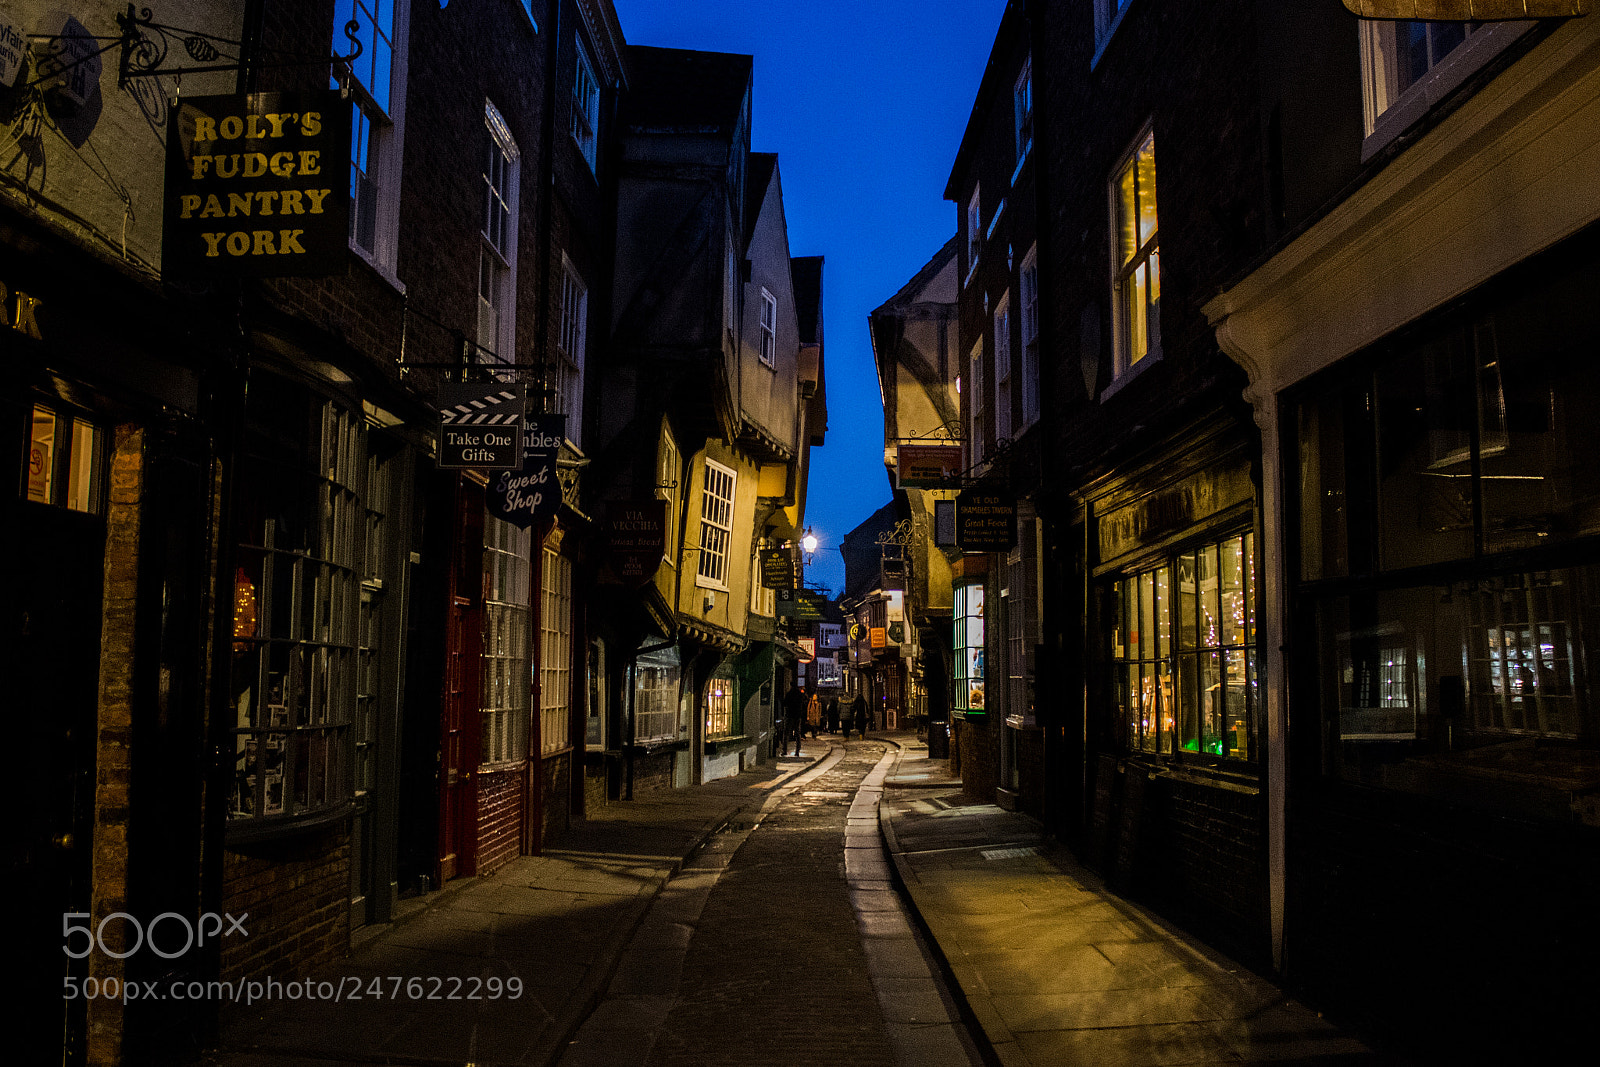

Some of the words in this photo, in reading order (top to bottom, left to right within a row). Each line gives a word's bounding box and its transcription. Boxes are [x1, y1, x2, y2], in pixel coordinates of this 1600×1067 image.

[0, 24, 24, 51] yfair
[0, 45, 18, 68] urity
[194, 112, 322, 141] ROLY'S
[192, 150, 321, 180] FUDGE
[179, 189, 331, 219] PANTRY
[201, 229, 306, 257] YORK
[523, 418, 538, 431] he
[447, 432, 479, 446] Take
[484, 432, 512, 446] One
[522, 431, 561, 448] mbles
[462, 448, 495, 462] Gifts
[496, 465, 549, 492] Sweet
[503, 490, 542, 514] Shop
[972, 496, 981, 504] YE
[983, 496, 999, 505] OLD
[625, 510, 643, 521] VIA
[960, 505, 991, 515] SHAMBLES
[992, 505, 1013, 515] TAVERN
[612, 520, 659, 531] VECCHIA
[987, 518, 1008, 528] Food
